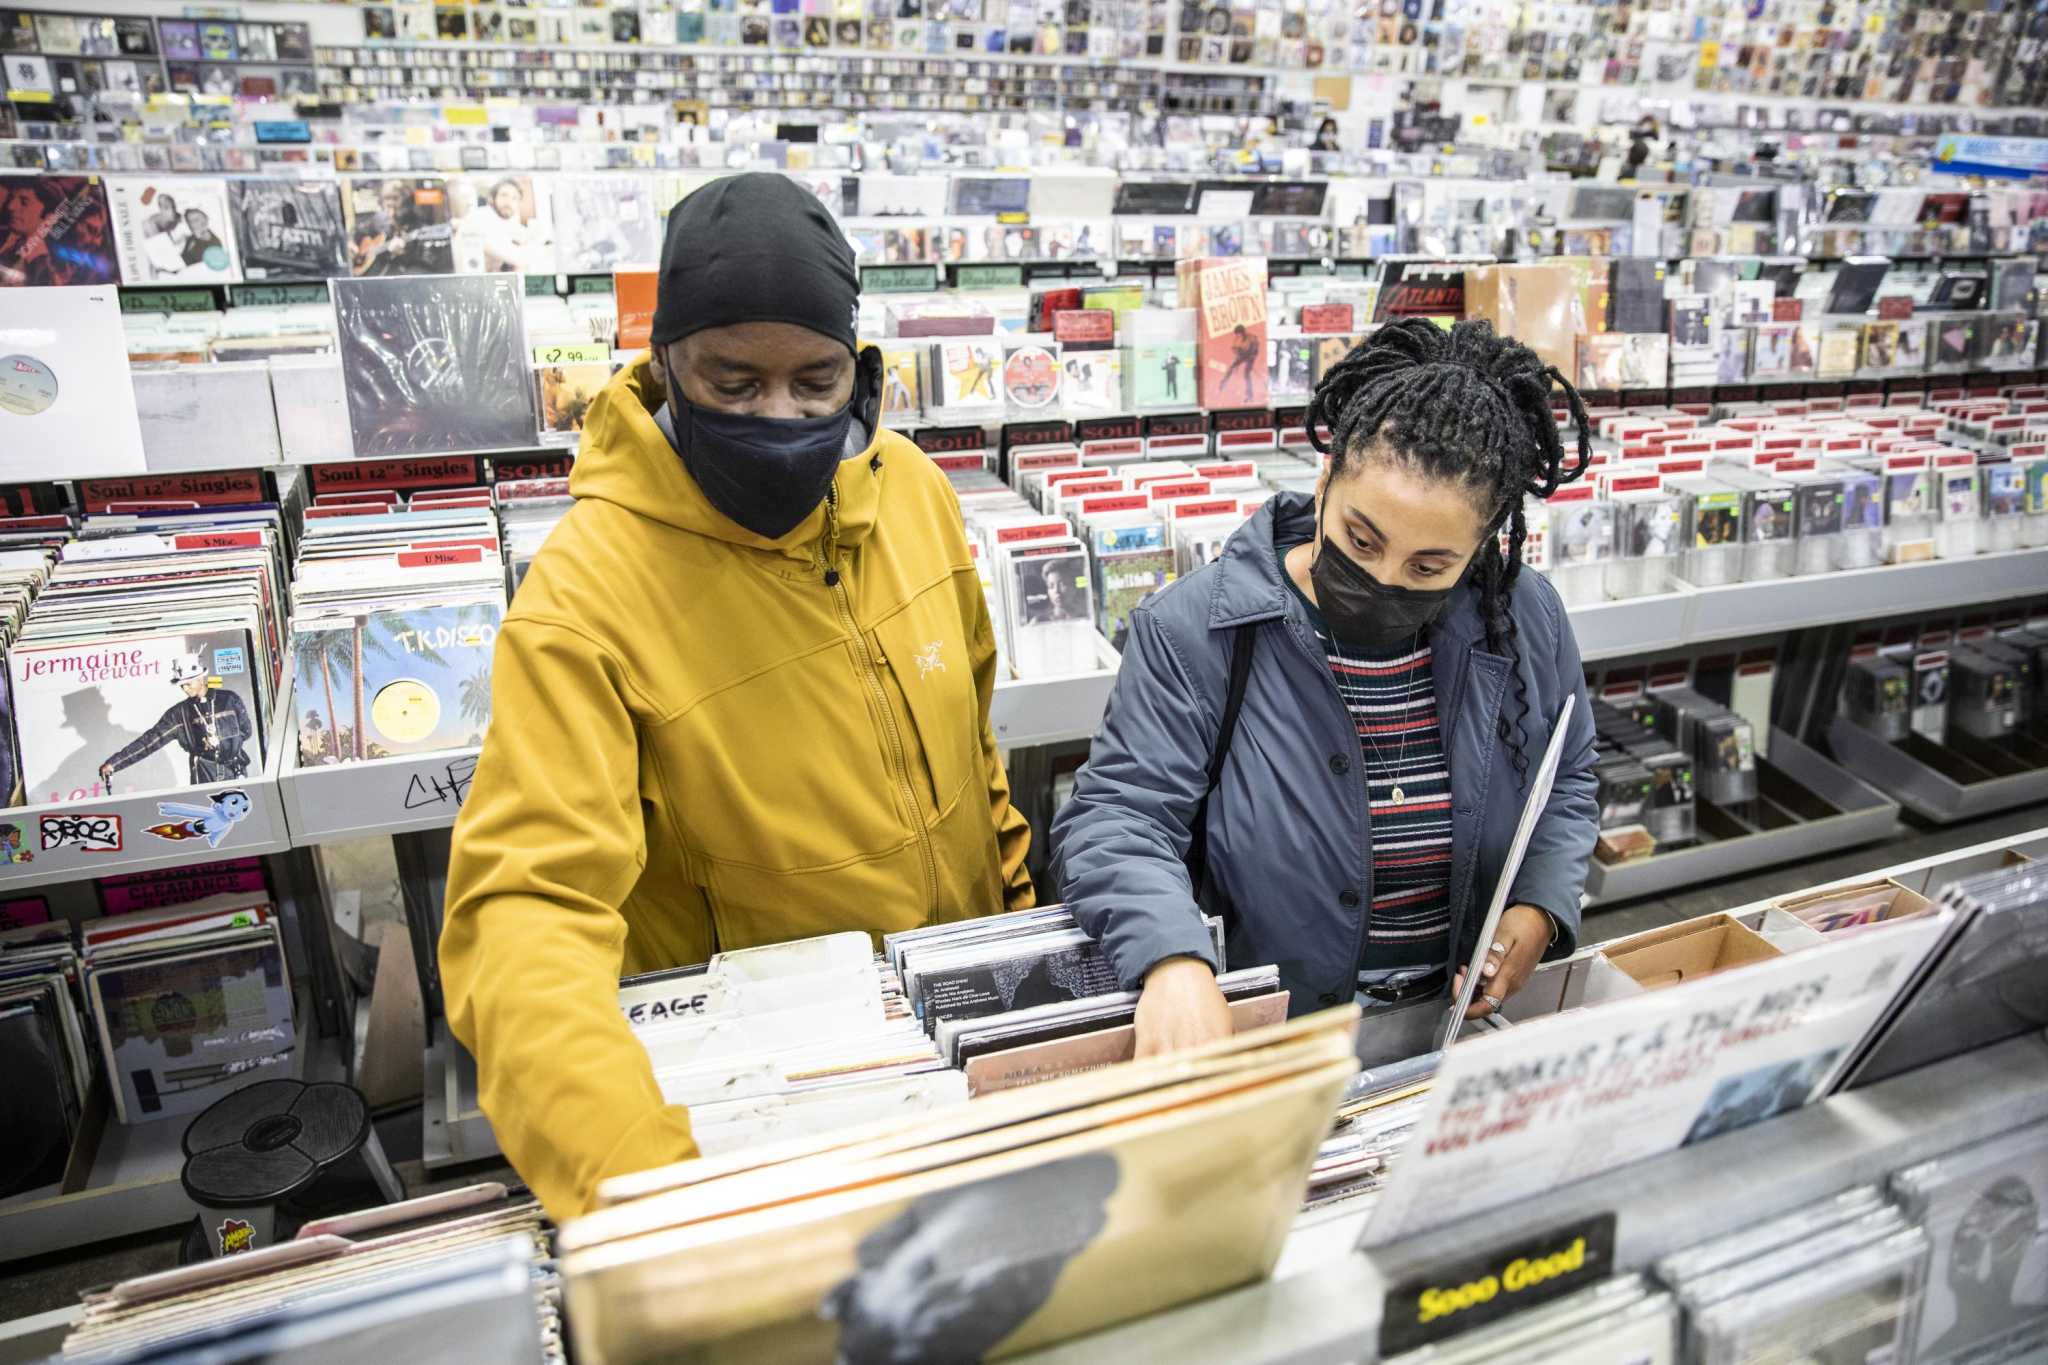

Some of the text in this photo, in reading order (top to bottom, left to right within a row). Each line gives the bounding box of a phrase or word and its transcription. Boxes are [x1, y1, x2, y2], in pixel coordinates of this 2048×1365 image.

[1206, 265, 1250, 300] JAMES
[1210, 294, 1261, 331] BROWN
[1082, 419, 1140, 439] soul
[1152, 416, 1207, 434] soul
[1219, 412, 1272, 428] soul
[921, 431, 982, 450] soul
[1010, 424, 1070, 443] soul
[320, 465, 362, 484] Soul
[402, 460, 470, 481] Singles
[498, 457, 572, 479] soul
[88, 481, 135, 499] Soul
[180, 476, 254, 498] Singles
[21, 650, 143, 682] jermaine
[79, 659, 161, 684] stewart
[128, 874, 241, 900] CLEARANCE
[622, 994, 708, 1024] EAGE
[1417, 1236, 1587, 1324] Sooo Good
